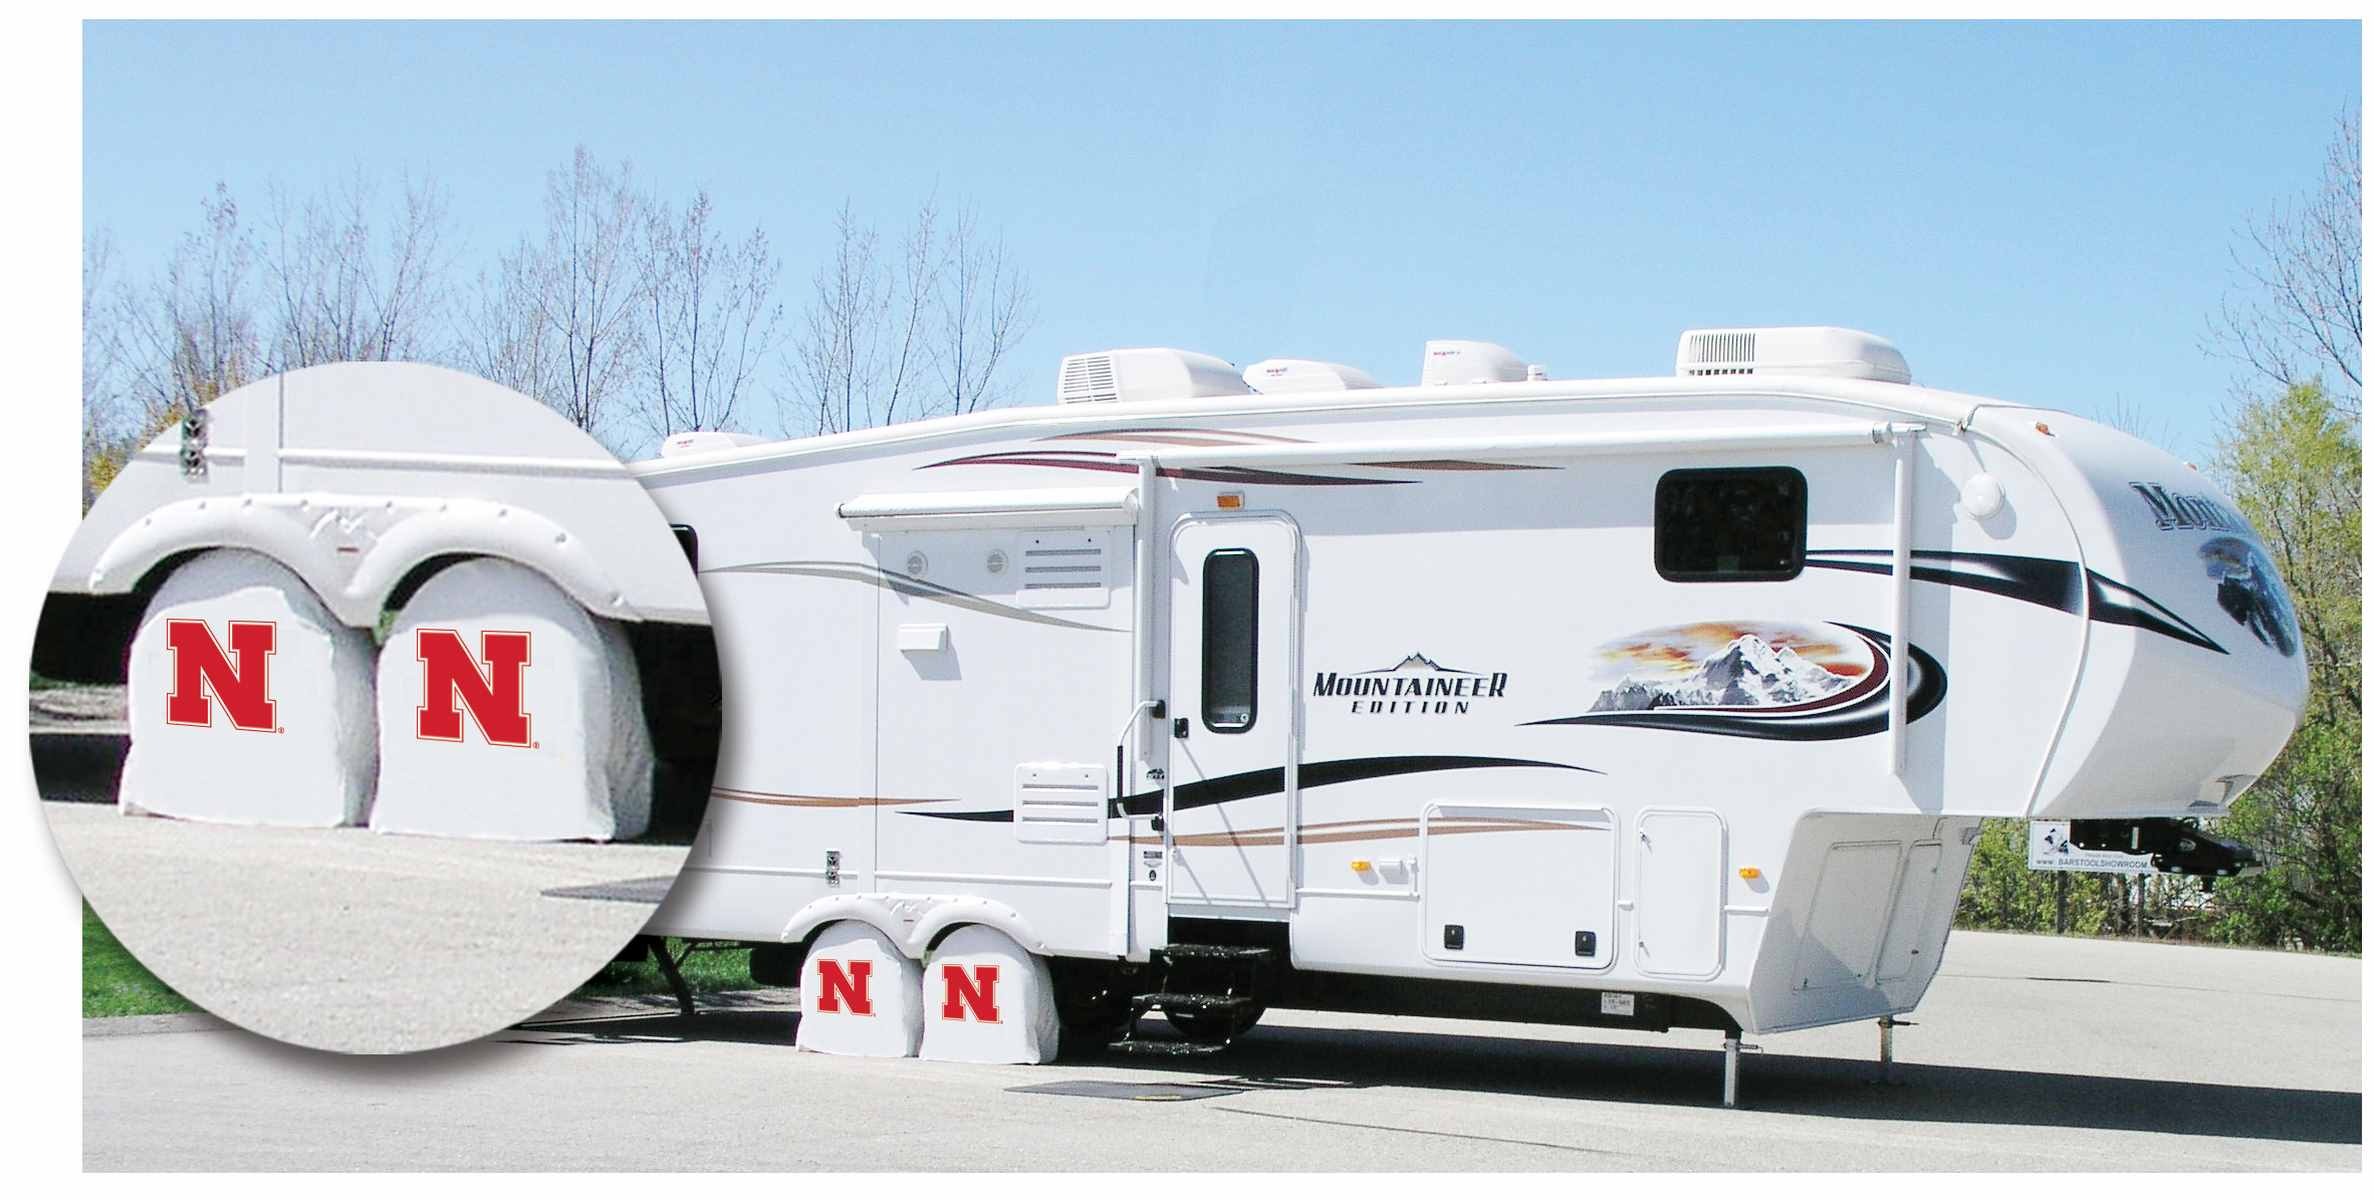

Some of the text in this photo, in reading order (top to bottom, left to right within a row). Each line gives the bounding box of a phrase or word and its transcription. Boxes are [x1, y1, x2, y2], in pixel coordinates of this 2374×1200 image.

[166, 618, 277, 732] N
[416, 628, 531, 748] N
[1313, 672, 1508, 697] MOUNTAINEER
[1351, 701, 1469, 714] EDITION
[817, 959, 873, 1016] N
[942, 964, 1000, 1024] N
